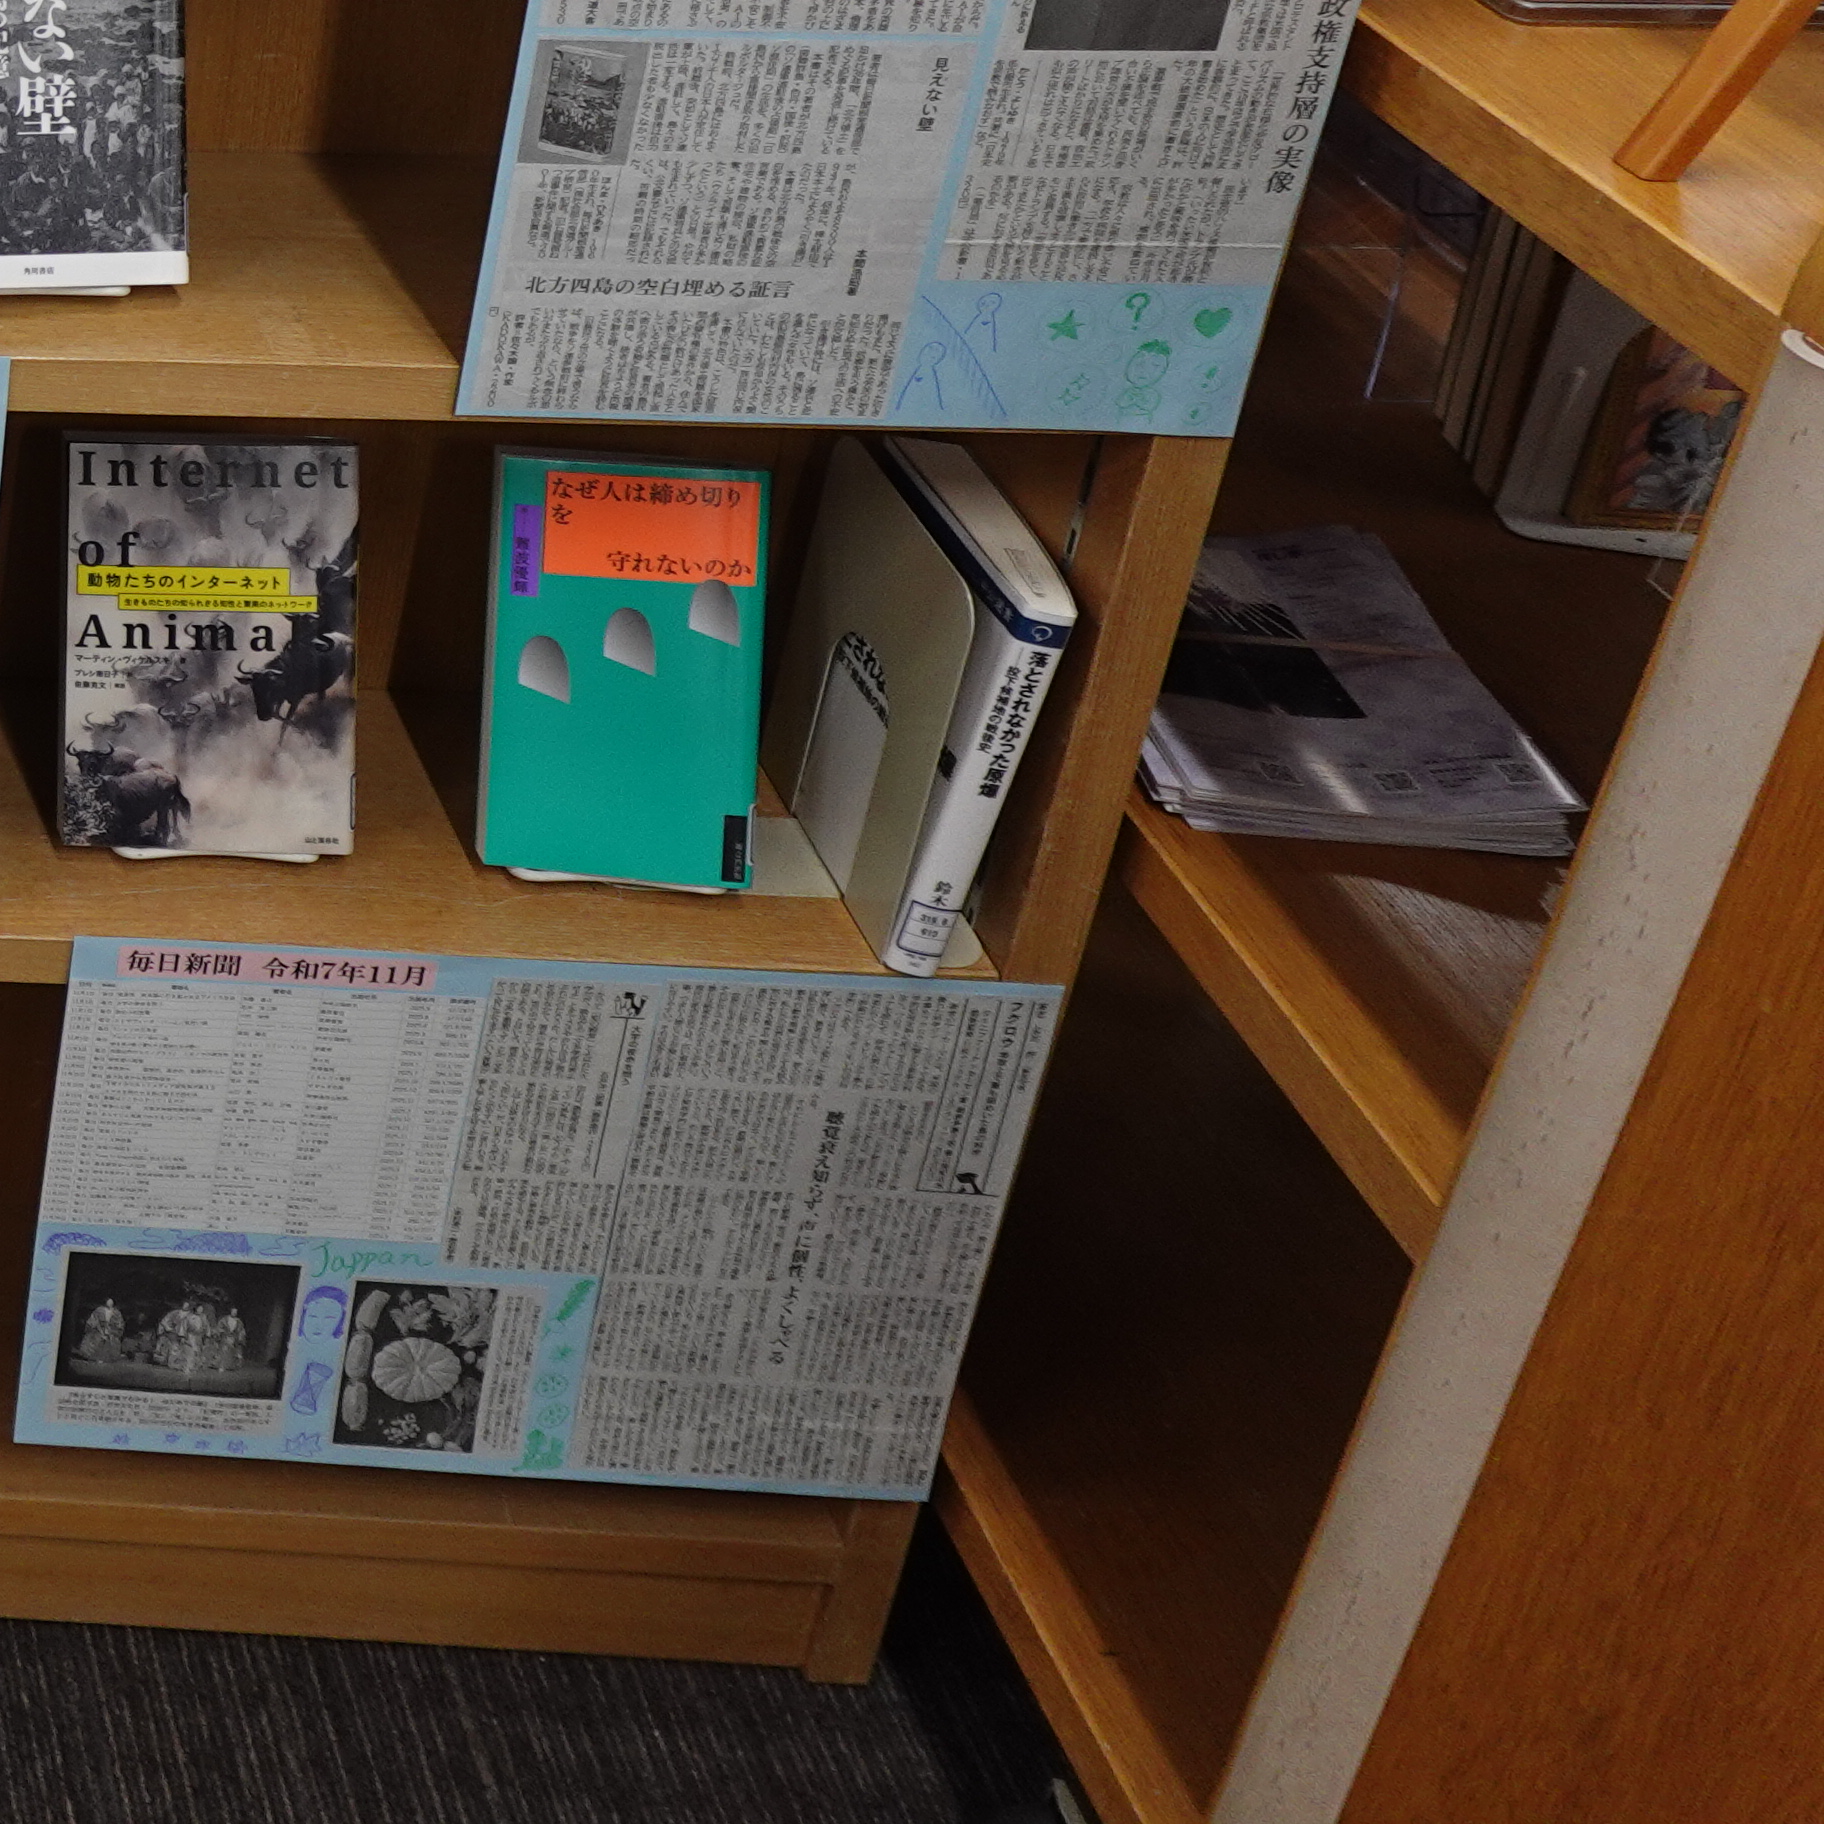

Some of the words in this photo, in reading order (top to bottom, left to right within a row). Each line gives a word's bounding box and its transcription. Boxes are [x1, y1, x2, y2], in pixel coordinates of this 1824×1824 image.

[911, 54, 953, 136] 見えない壁
[523, 275, 796, 302] 北方四島の空白埋める証言
[77, 449, 350, 491] Internet
[551, 477, 743, 509] なぜ人は締め切り
[551, 503, 574, 526] を
[78, 531, 141, 568] of
[606, 550, 753, 578] 守れないのか
[86, 572, 283, 591] 動物たちのインターネット
[977, 650, 1053, 800] 落とされなかった原爆
[127, 947, 242, 978] 毎日新聞
[263, 955, 429, 988] 令和7年11月
